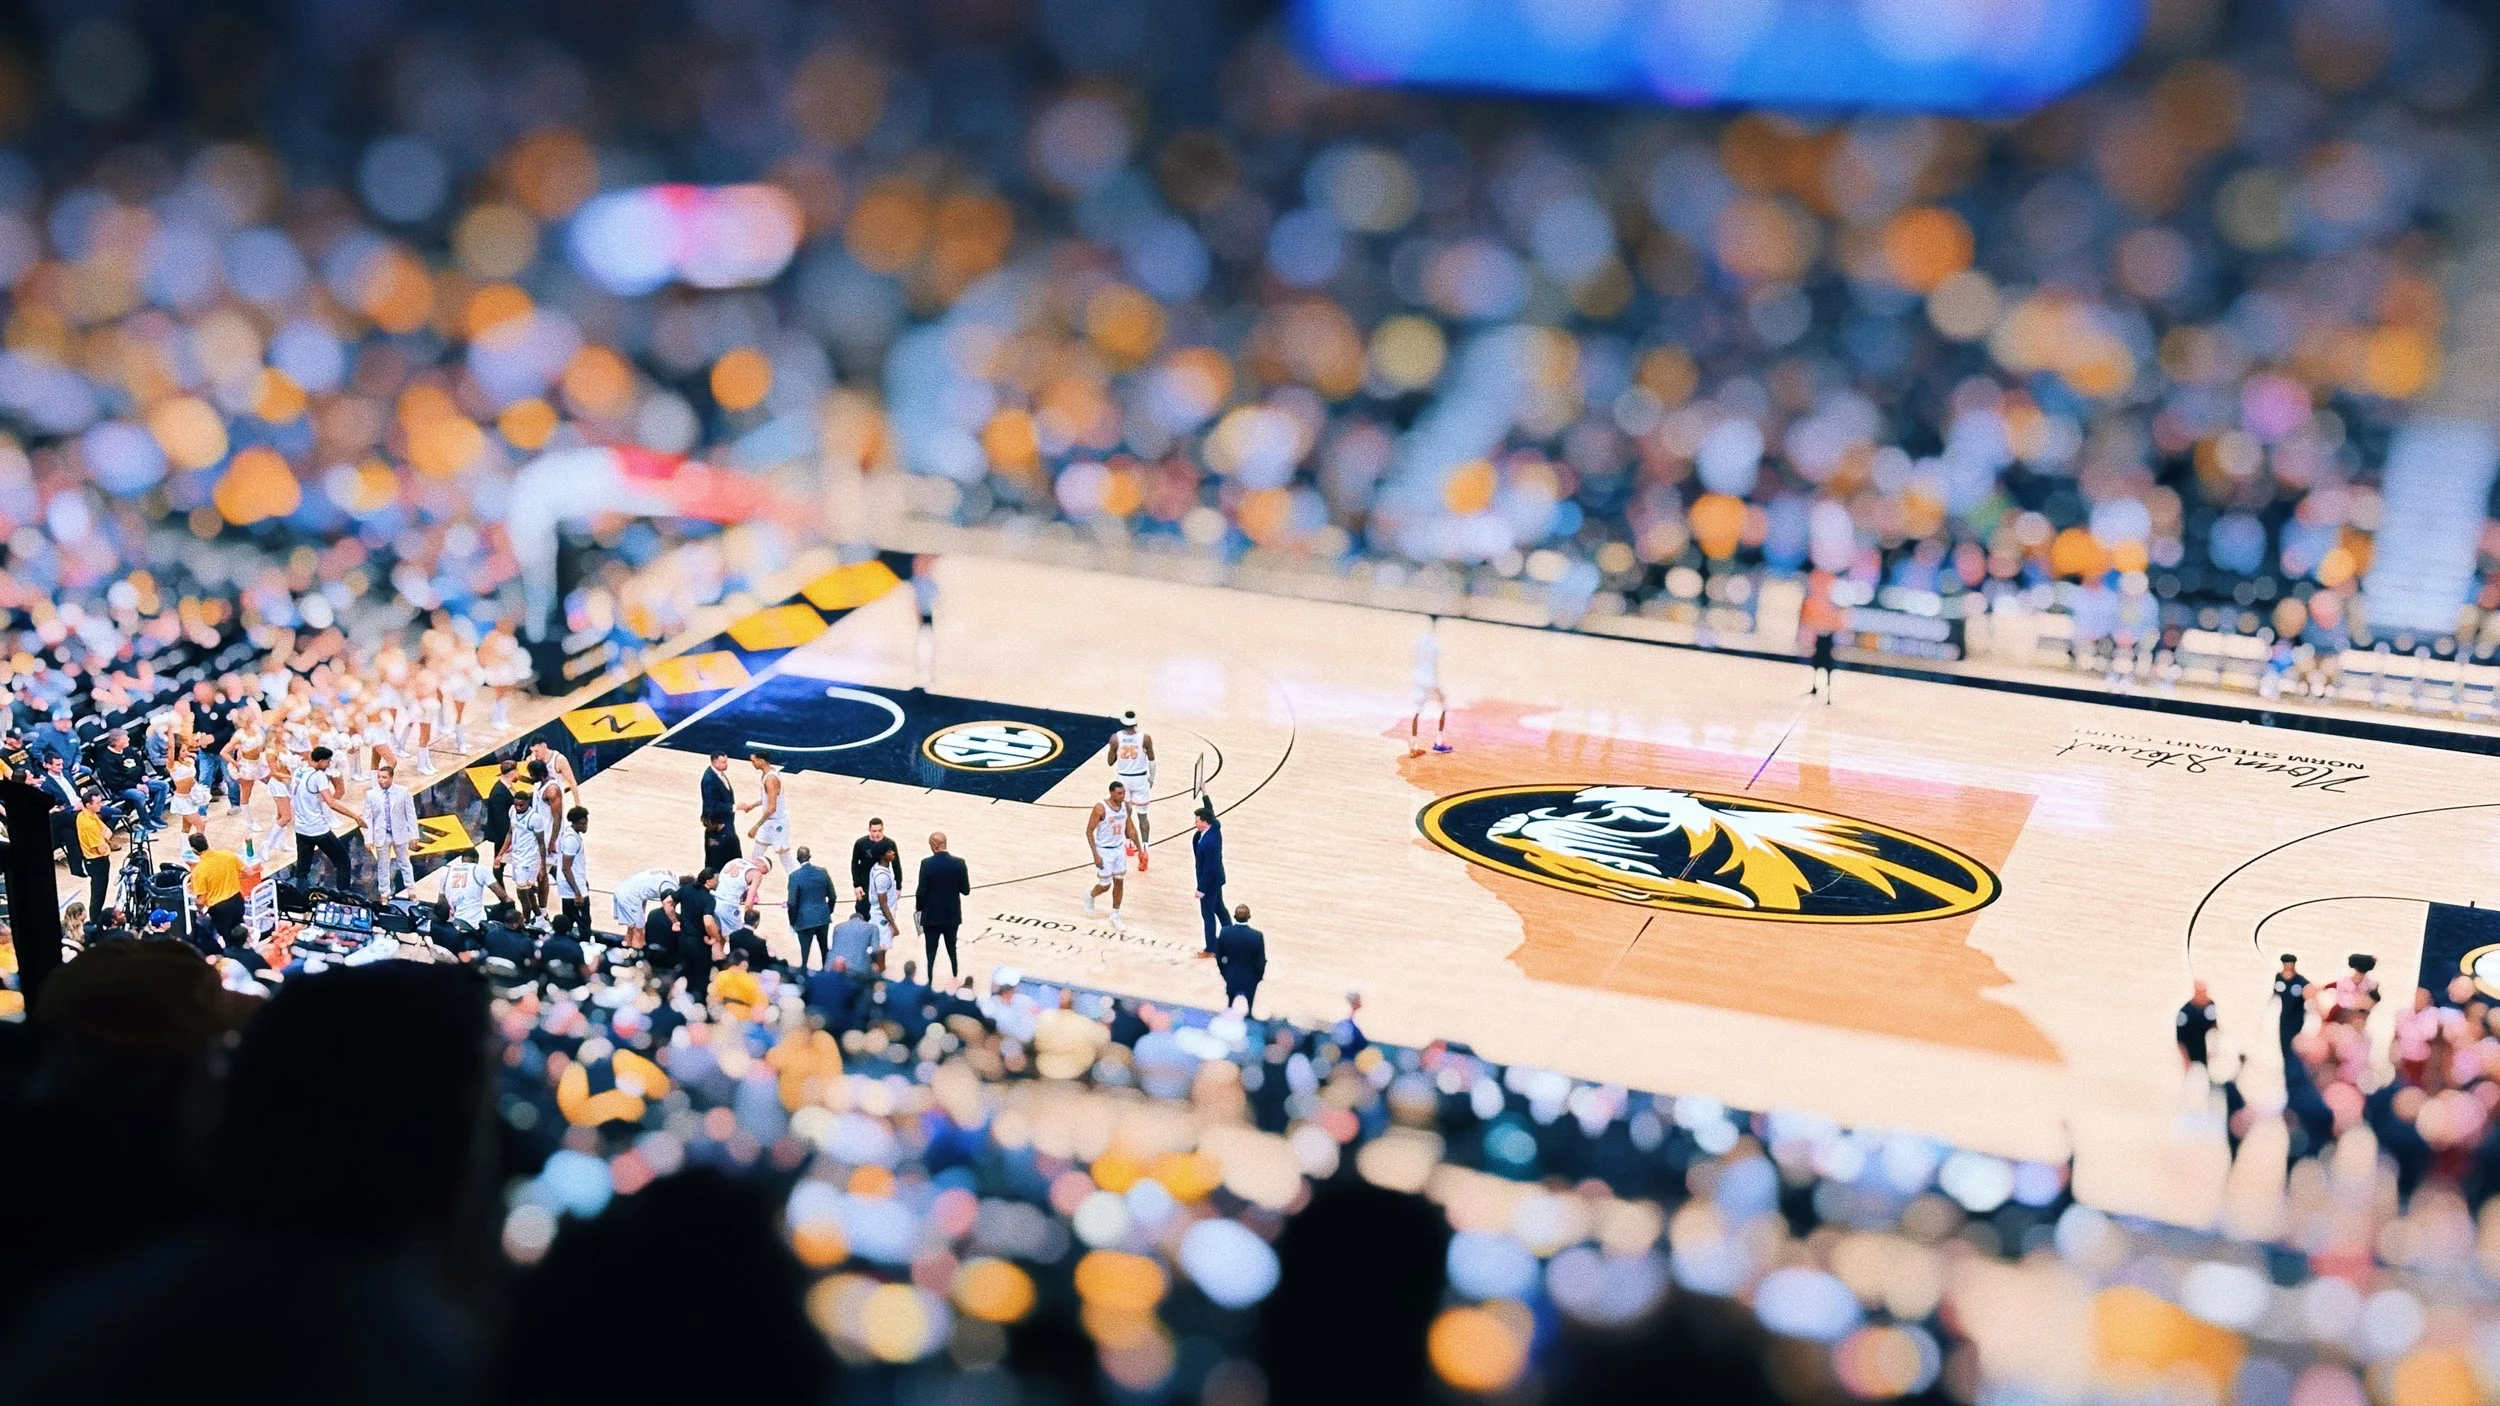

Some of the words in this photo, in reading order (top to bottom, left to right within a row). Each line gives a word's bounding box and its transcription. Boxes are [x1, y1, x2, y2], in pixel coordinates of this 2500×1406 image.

[2161, 740, 2279, 759] STEWART
[2287, 755, 2365, 770] NORM
[988, 913, 1078, 932] COURT
